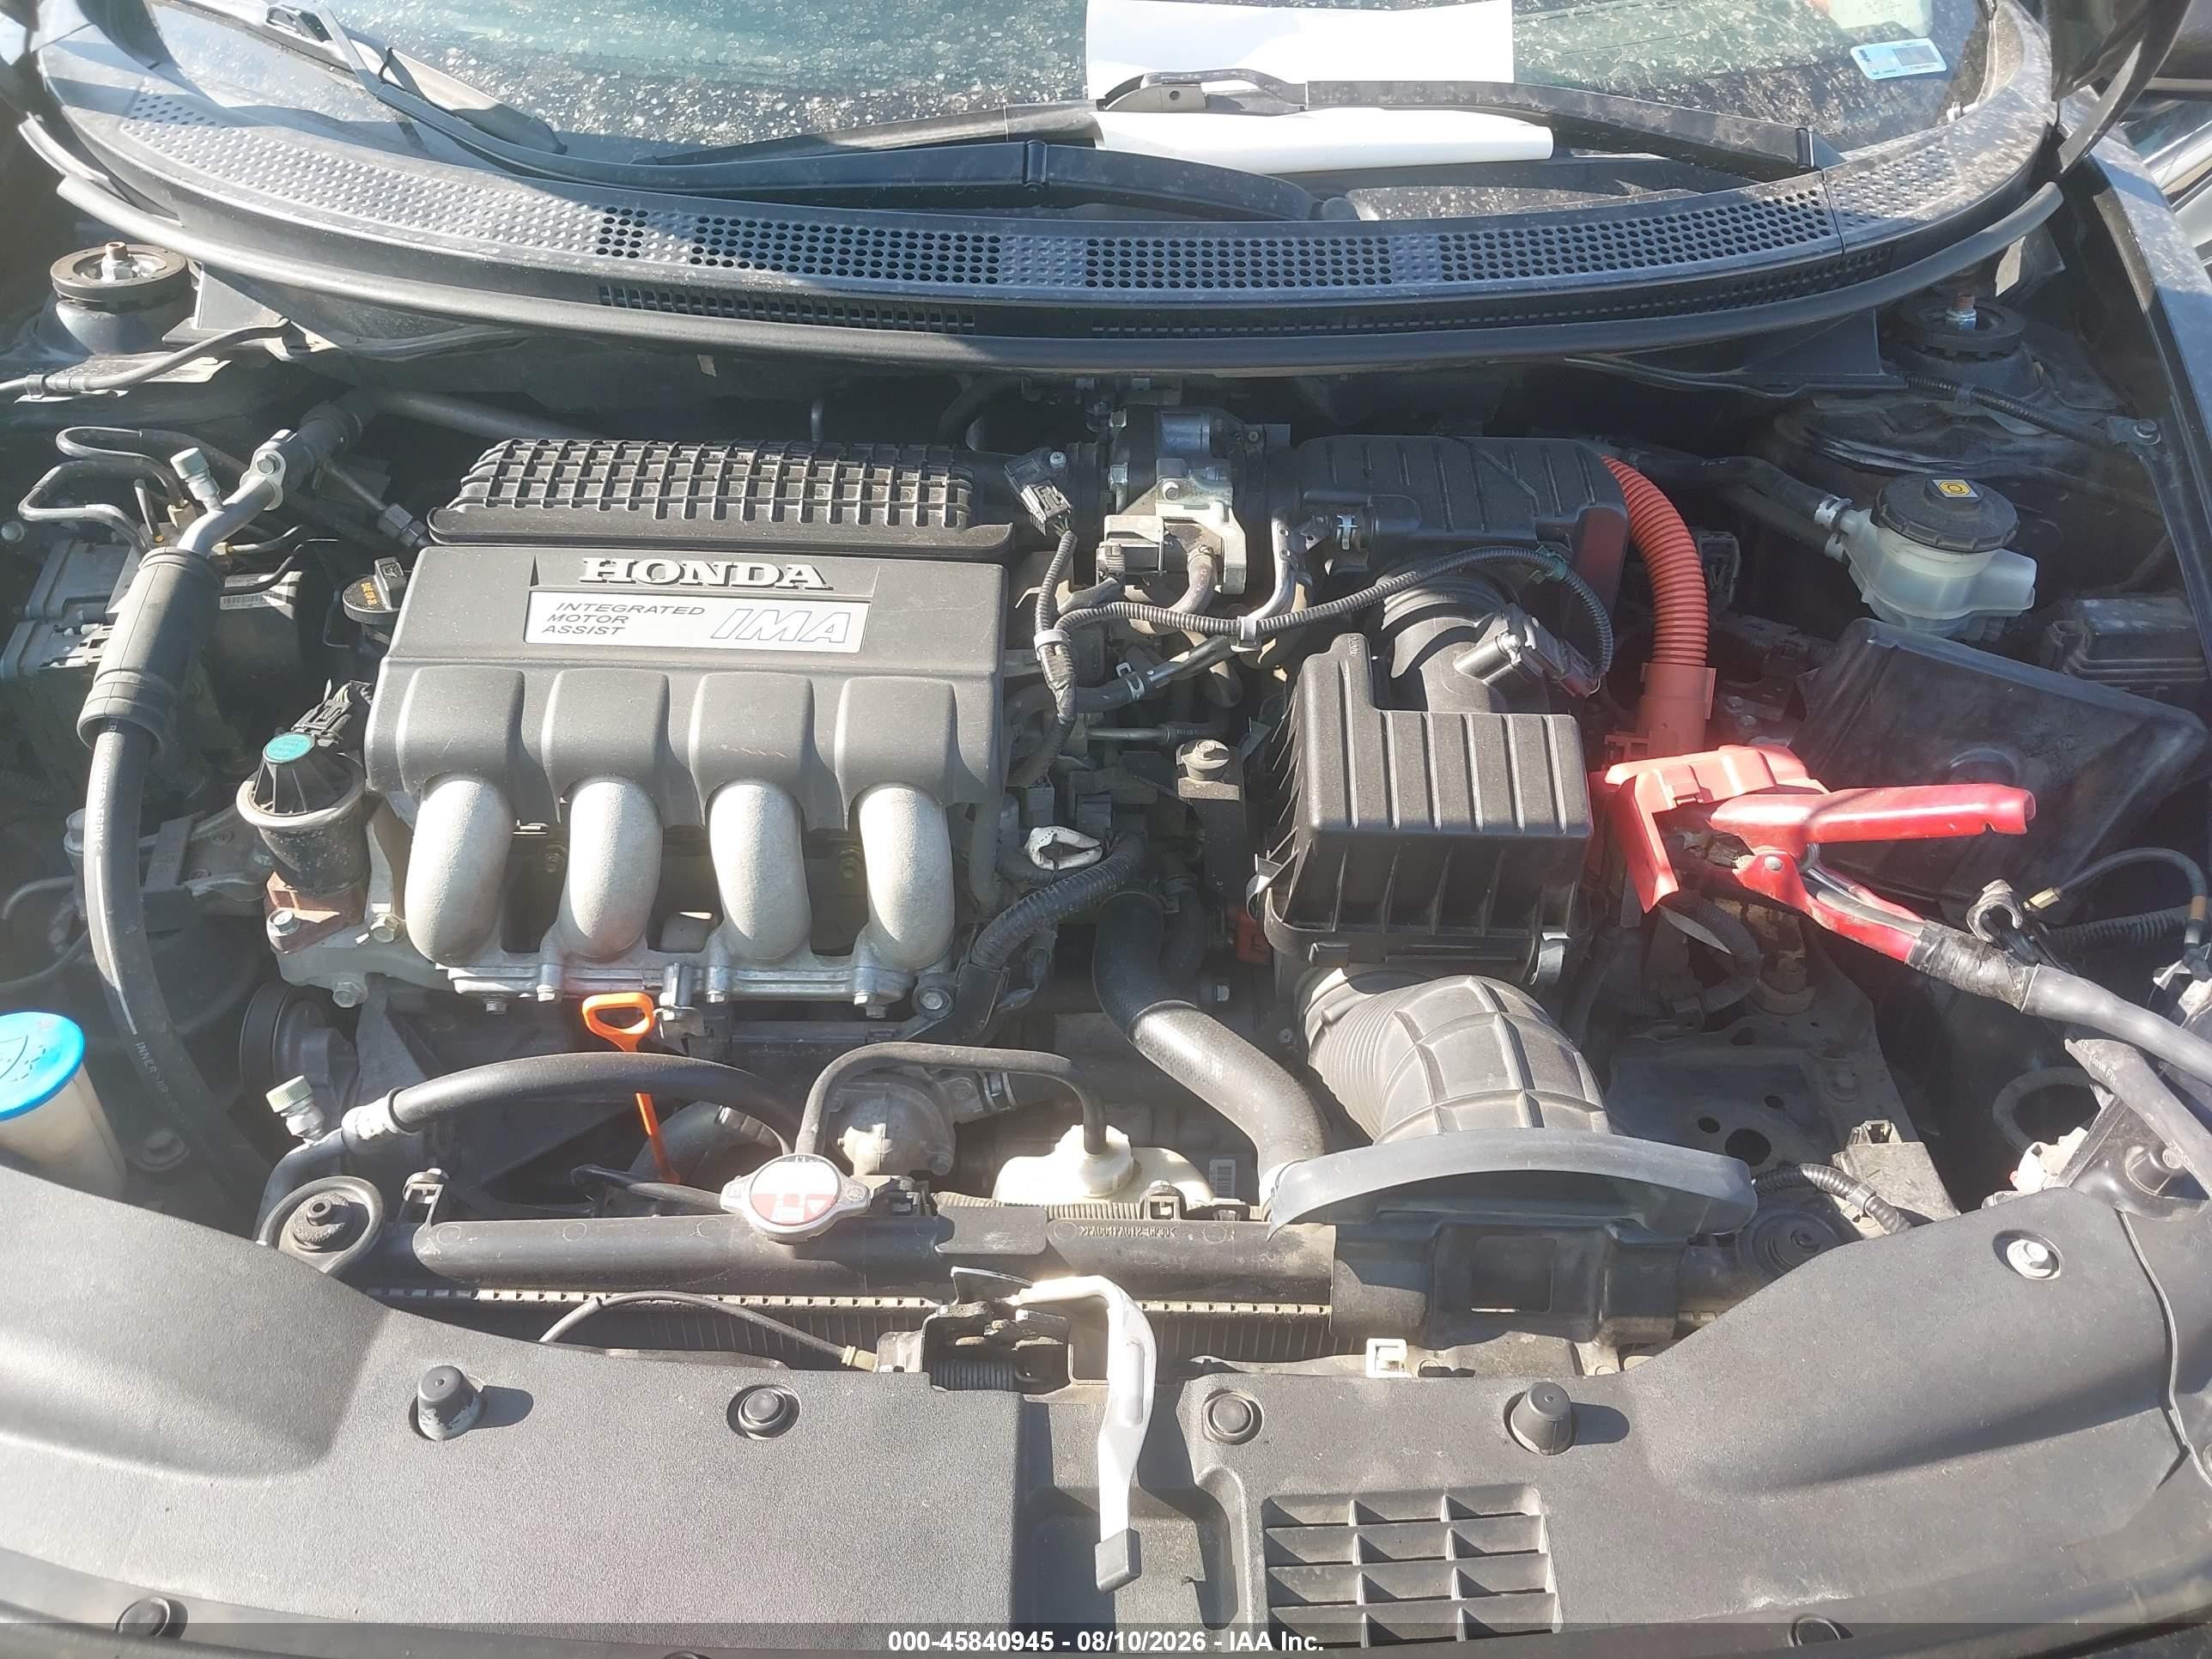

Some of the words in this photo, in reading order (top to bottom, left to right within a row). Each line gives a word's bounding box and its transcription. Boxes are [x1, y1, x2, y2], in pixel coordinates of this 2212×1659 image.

[580, 557, 834, 591] HONDA
[556, 603, 706, 616] INTEGRATED
[546, 614, 630, 625] MOTOR
[710, 608, 851, 643] IMA
[542, 625, 626, 636] ASSIST
